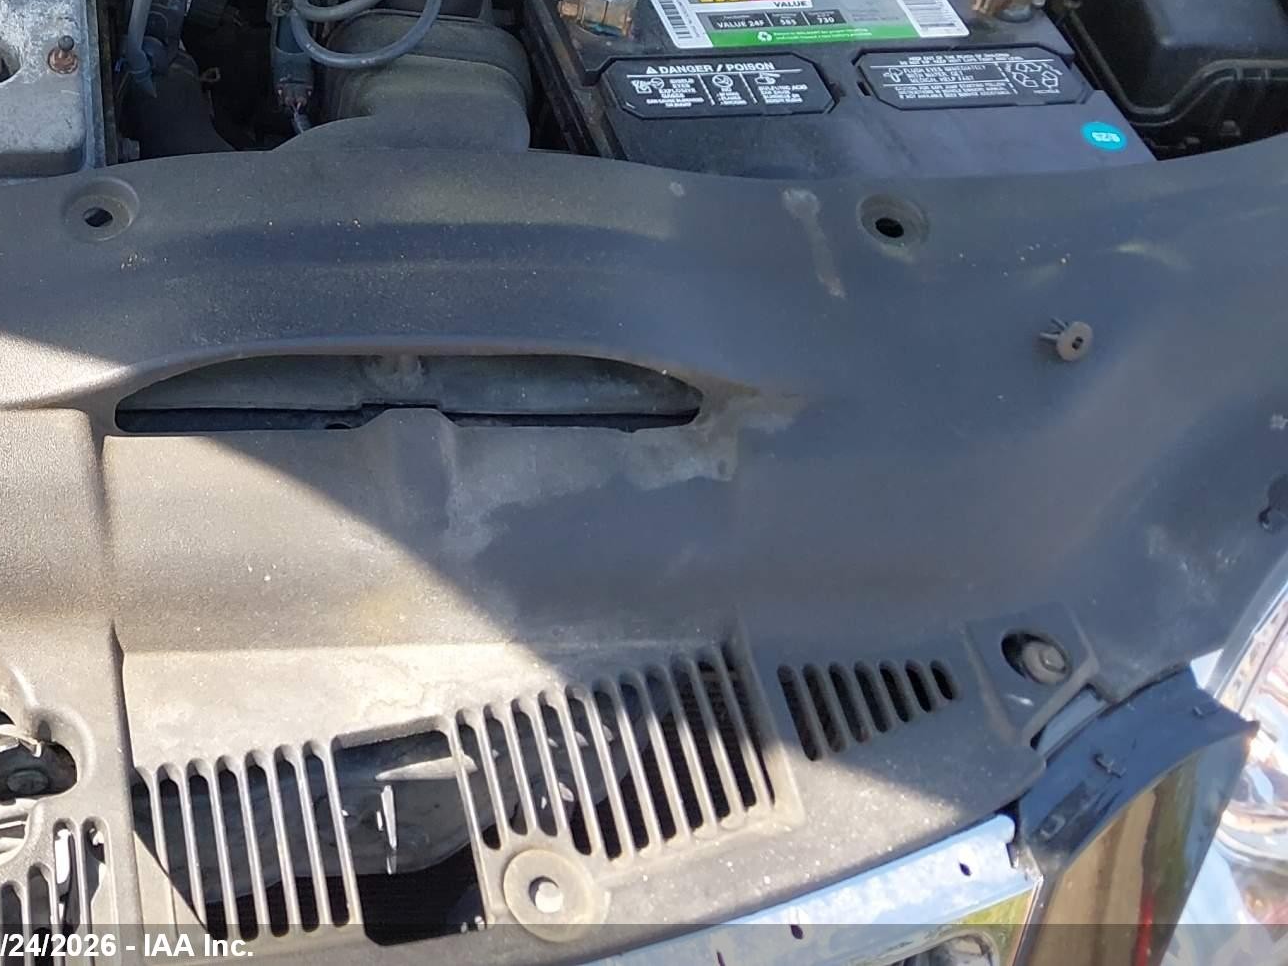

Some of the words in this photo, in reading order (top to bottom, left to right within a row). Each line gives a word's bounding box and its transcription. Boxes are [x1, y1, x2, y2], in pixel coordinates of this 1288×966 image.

[773, 0, 809, 8] VALUE
[816, 16, 835, 24] 730
[716, 20, 748, 29] VALUE
[658, 63, 713, 74] DANGER
[724, 61, 776, 72] POISON
